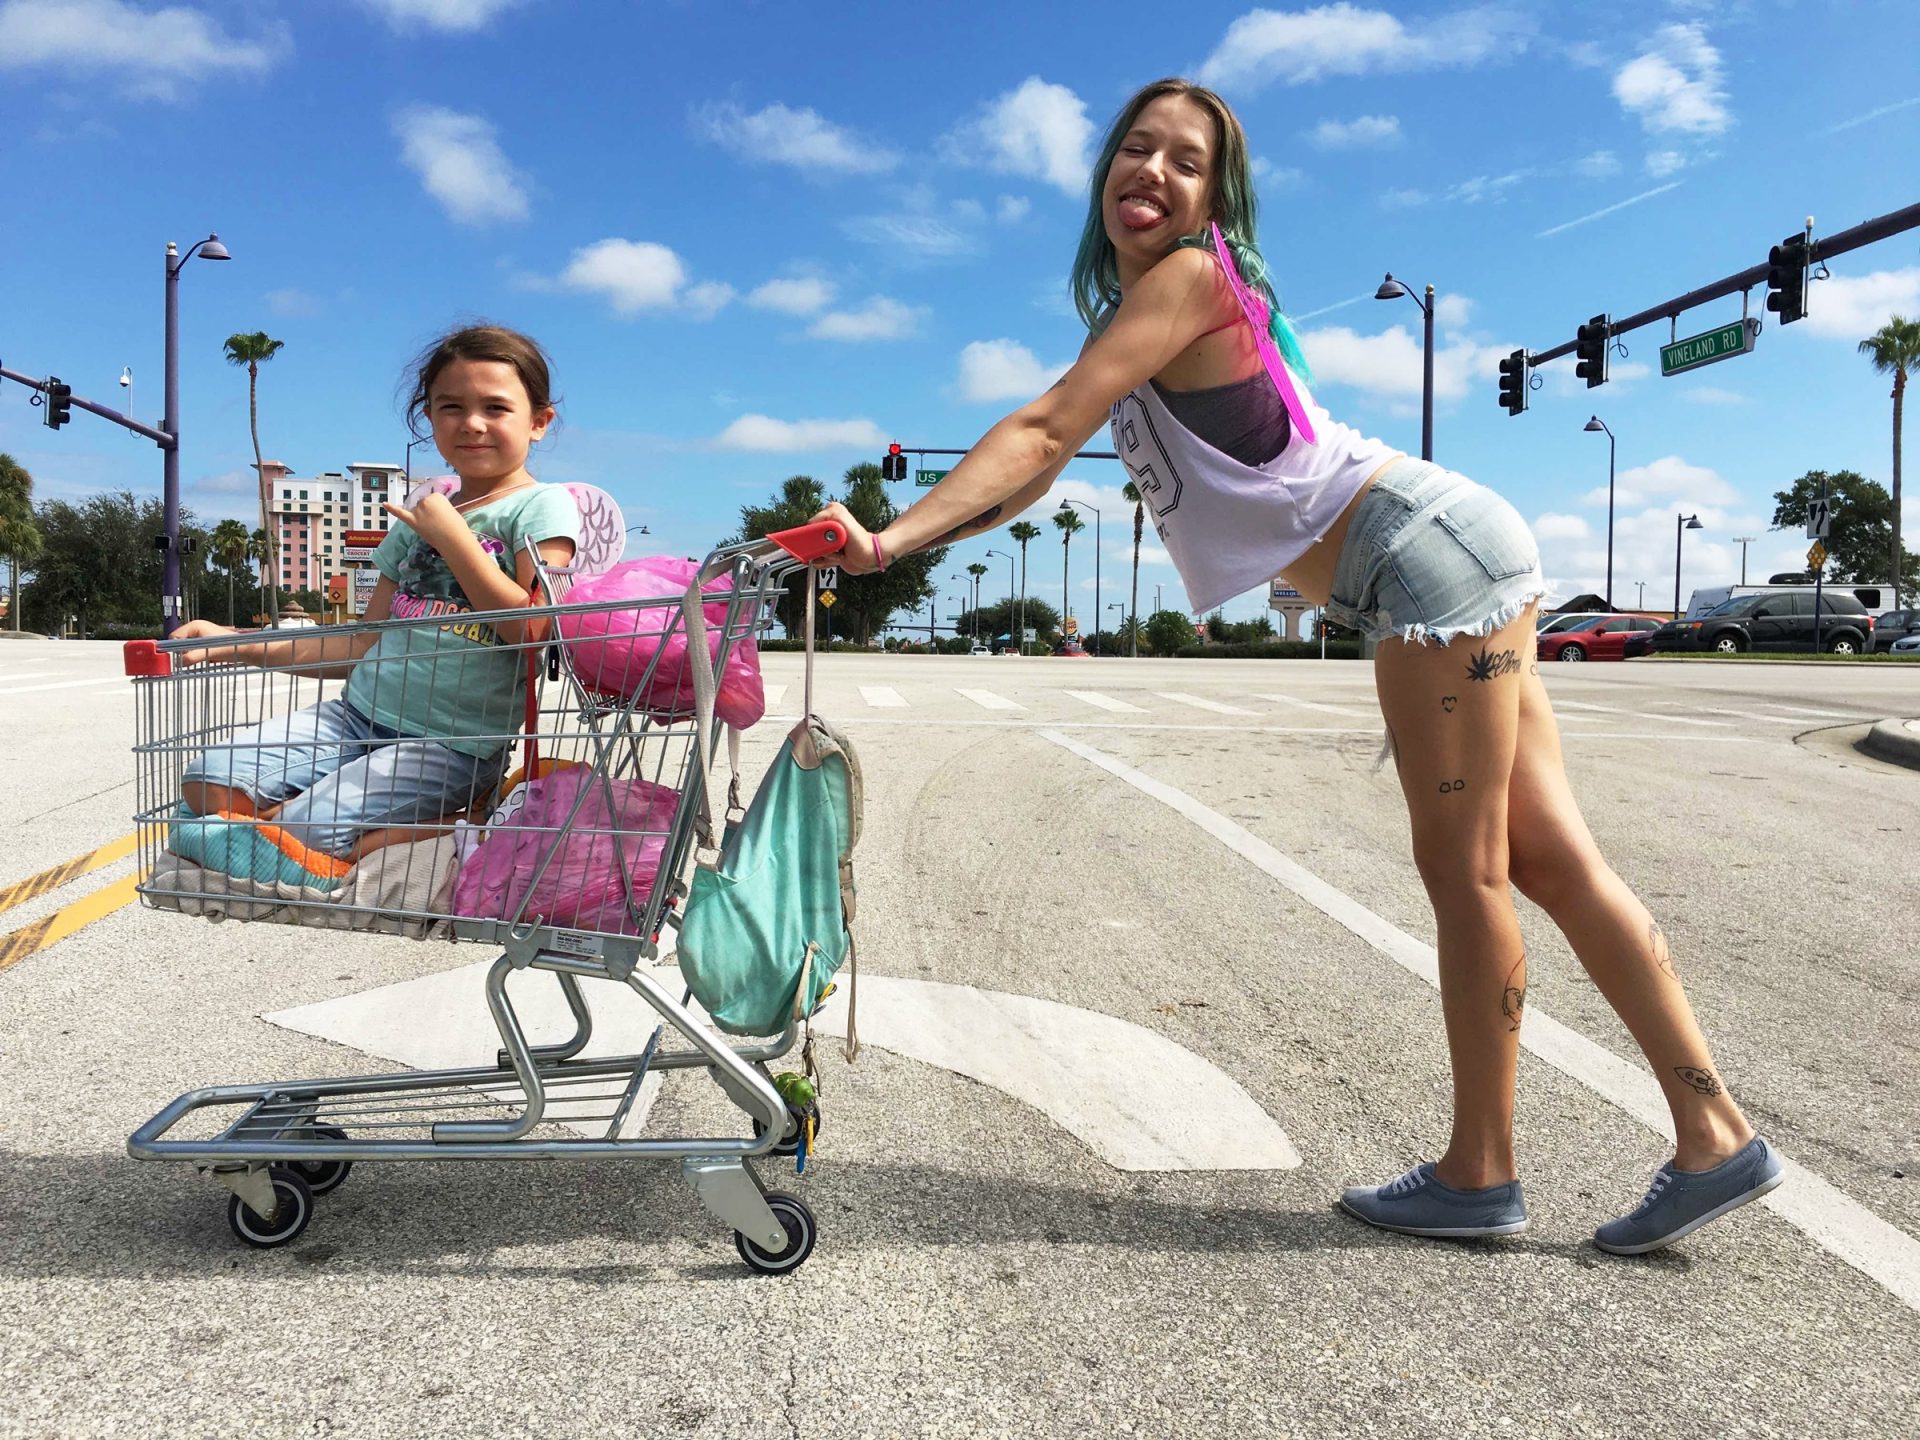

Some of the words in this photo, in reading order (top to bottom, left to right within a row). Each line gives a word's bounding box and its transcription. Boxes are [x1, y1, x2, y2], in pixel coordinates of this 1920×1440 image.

[1668, 337, 1715, 367] VINELAND
[1722, 330, 1737, 350] RD
[918, 473, 937, 483] US
